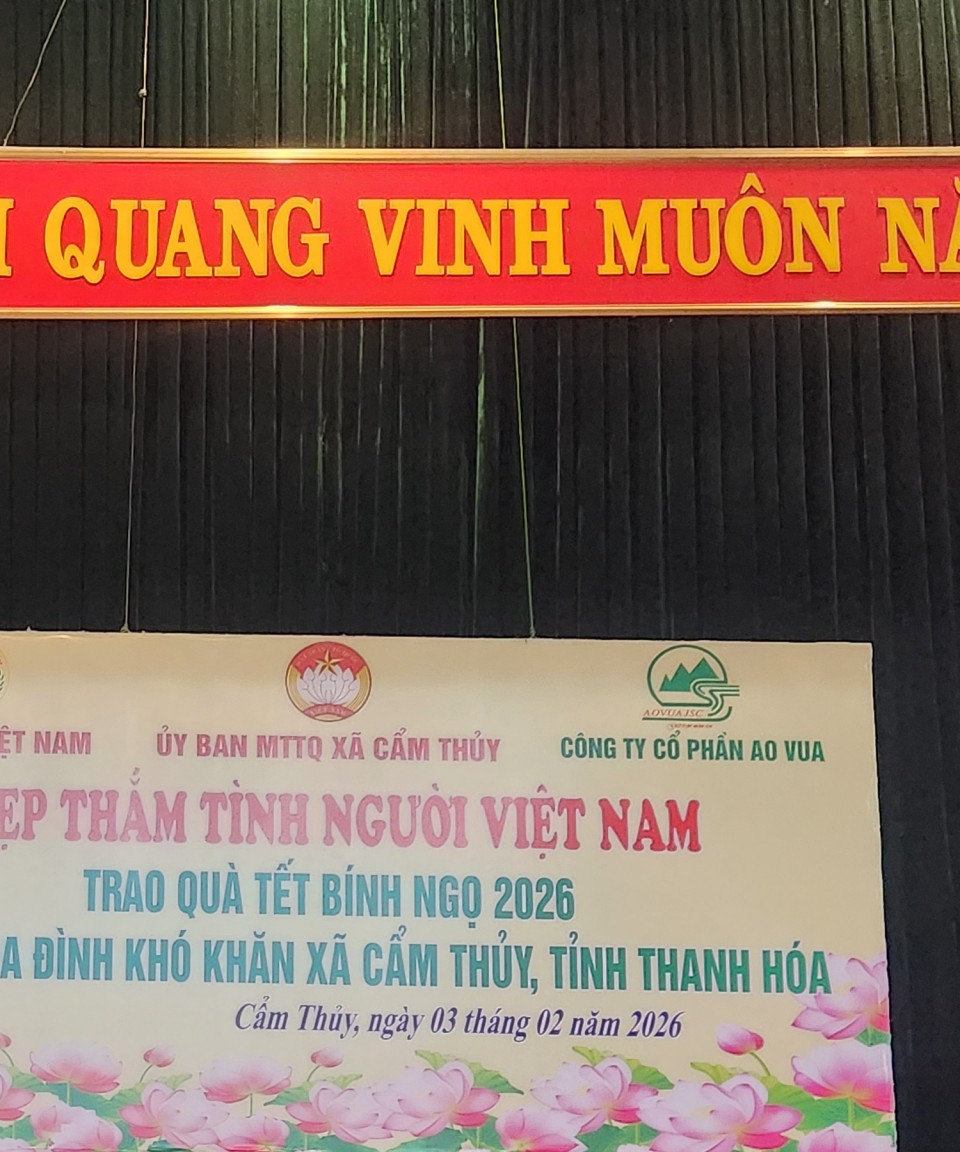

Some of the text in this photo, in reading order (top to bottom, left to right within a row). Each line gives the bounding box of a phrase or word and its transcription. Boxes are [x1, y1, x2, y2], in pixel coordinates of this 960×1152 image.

[44, 197, 330, 283] QUANG
[358, 199, 570, 275] VINH
[596, 173, 844, 275] MUÔN
[34, 731, 91, 754] NAM
[157, 725, 500, 762] ỦY BAN MTTQ XÃ CẨM THỦY
[561, 730, 825, 761] CÔNG TY CỔ PHẦN AO VUA
[200, 779, 309, 845] TÌNH
[322, 783, 468, 848] NGƯỜI
[481, 784, 586, 859] VIỆT
[599, 798, 701, 852] NAM
[84, 858, 574, 928] TRAO QUÀ TẾT BÍNH NGỌ 2026
[33, 928, 113, 981] ĐÌNH
[126, 930, 190, 982] KHÓ
[204, 931, 294, 984] KHĂN
[306, 934, 351, 985] XÃ
[363, 925, 437, 986] CẨM
[450, 930, 538, 994] THỦY,
[550, 931, 626, 990] TỈNH
[638, 948, 750, 992] THANH
[763, 941, 831, 994] HÓA
[236, 996, 683, 1042] Cẩm Thủy, ngày 03 tháng 02 năm 2026
